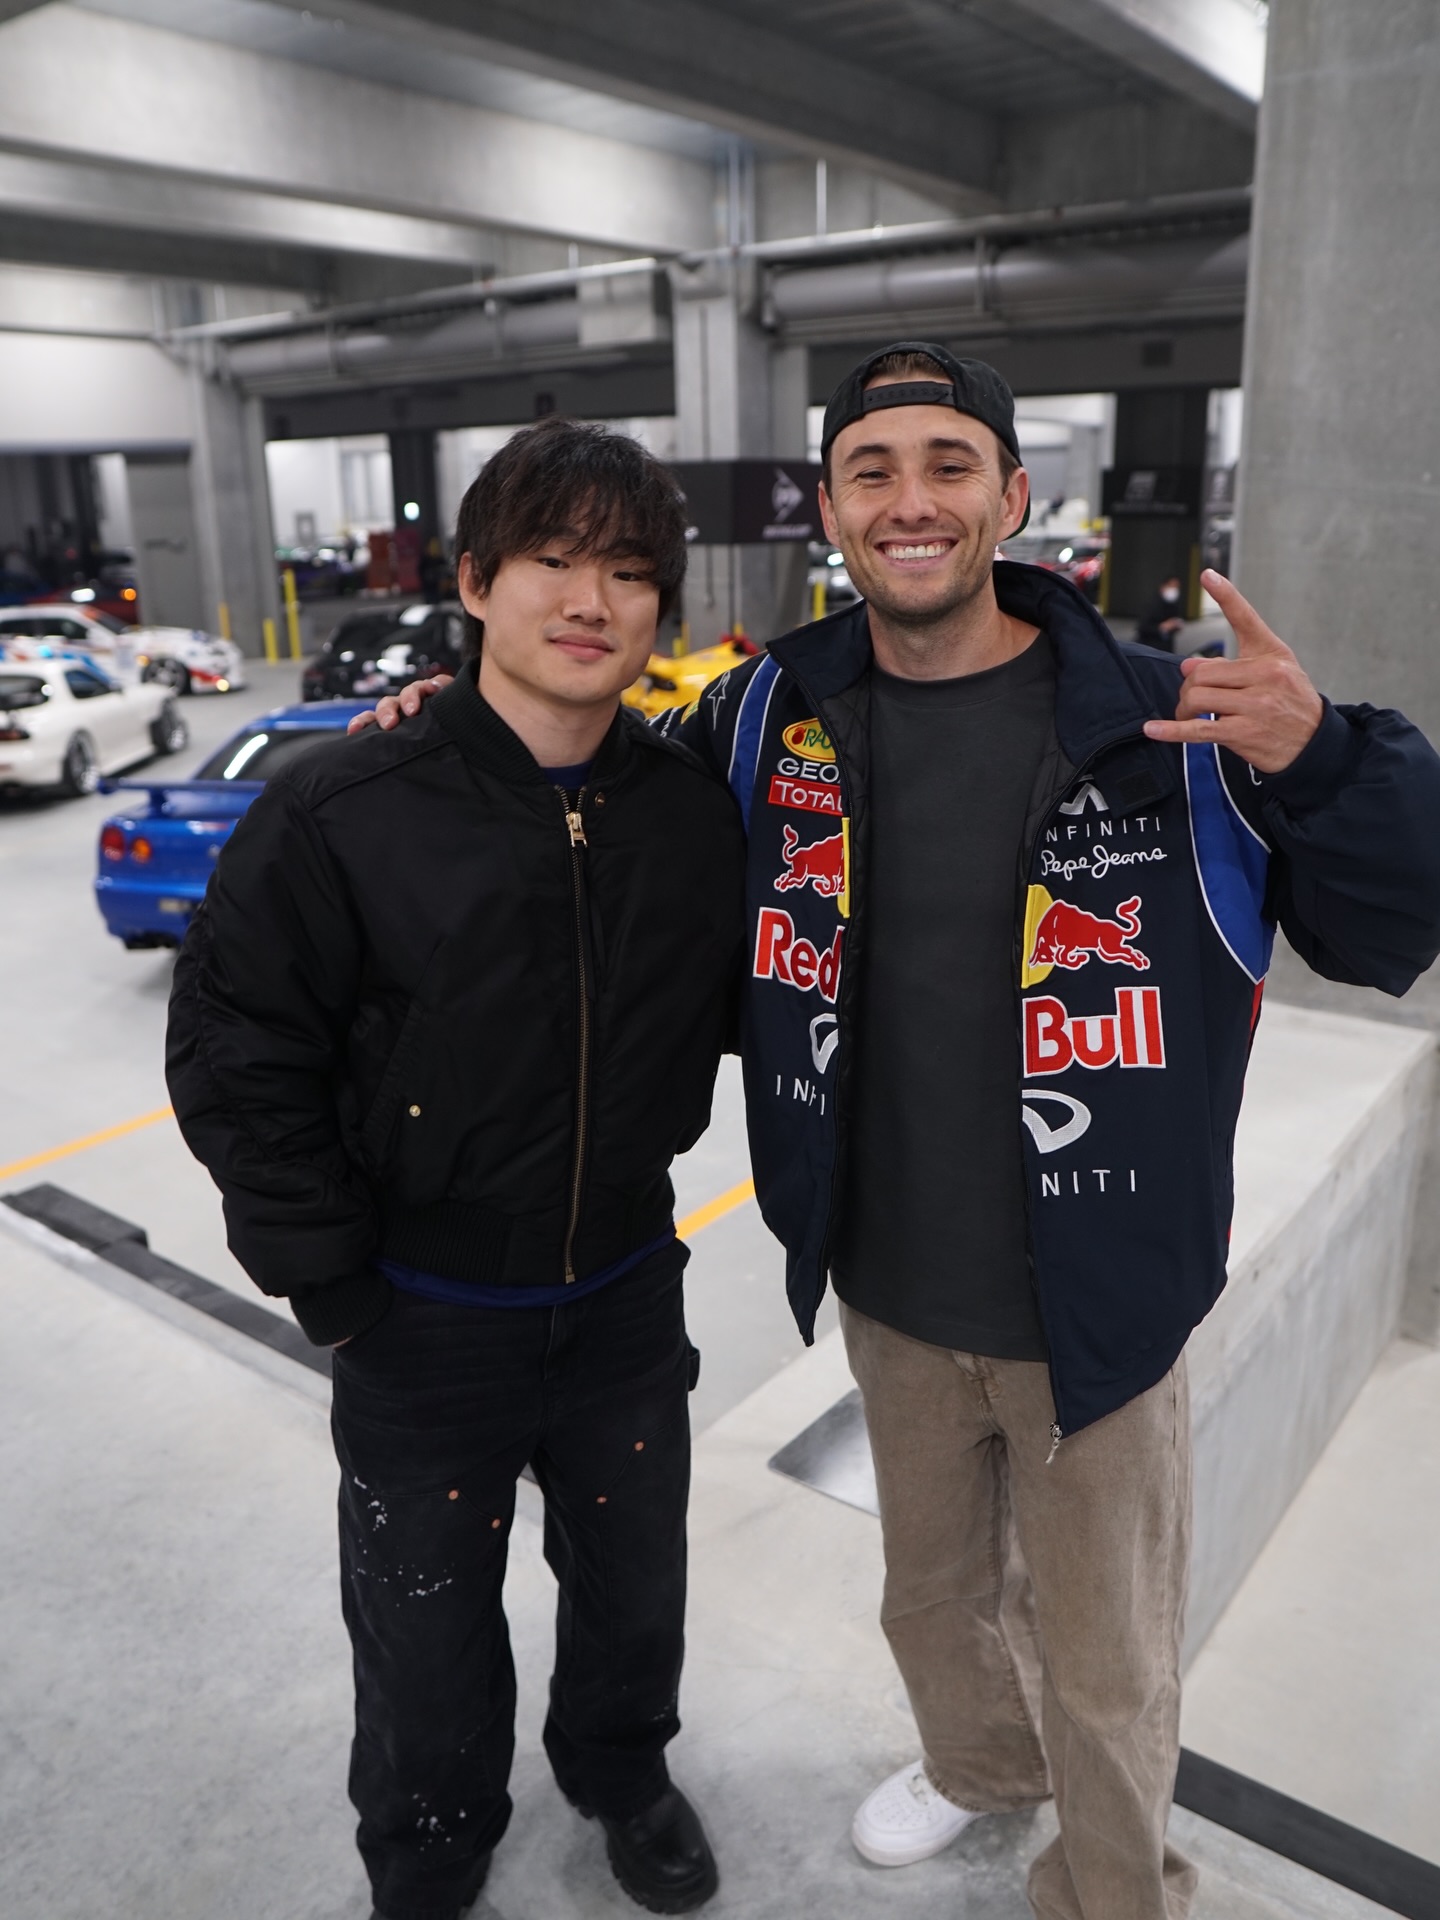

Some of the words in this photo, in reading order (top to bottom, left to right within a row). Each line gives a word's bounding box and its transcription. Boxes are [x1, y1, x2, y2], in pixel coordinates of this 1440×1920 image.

[777, 757, 841, 783] GEO
[1041, 849, 1092, 881] Pepe
[1091, 844, 1168, 879] Jeans
[753, 906, 845, 1005] Red
[1022, 986, 1166, 1079] Bull
[1041, 1169, 1136, 1197] NITI
